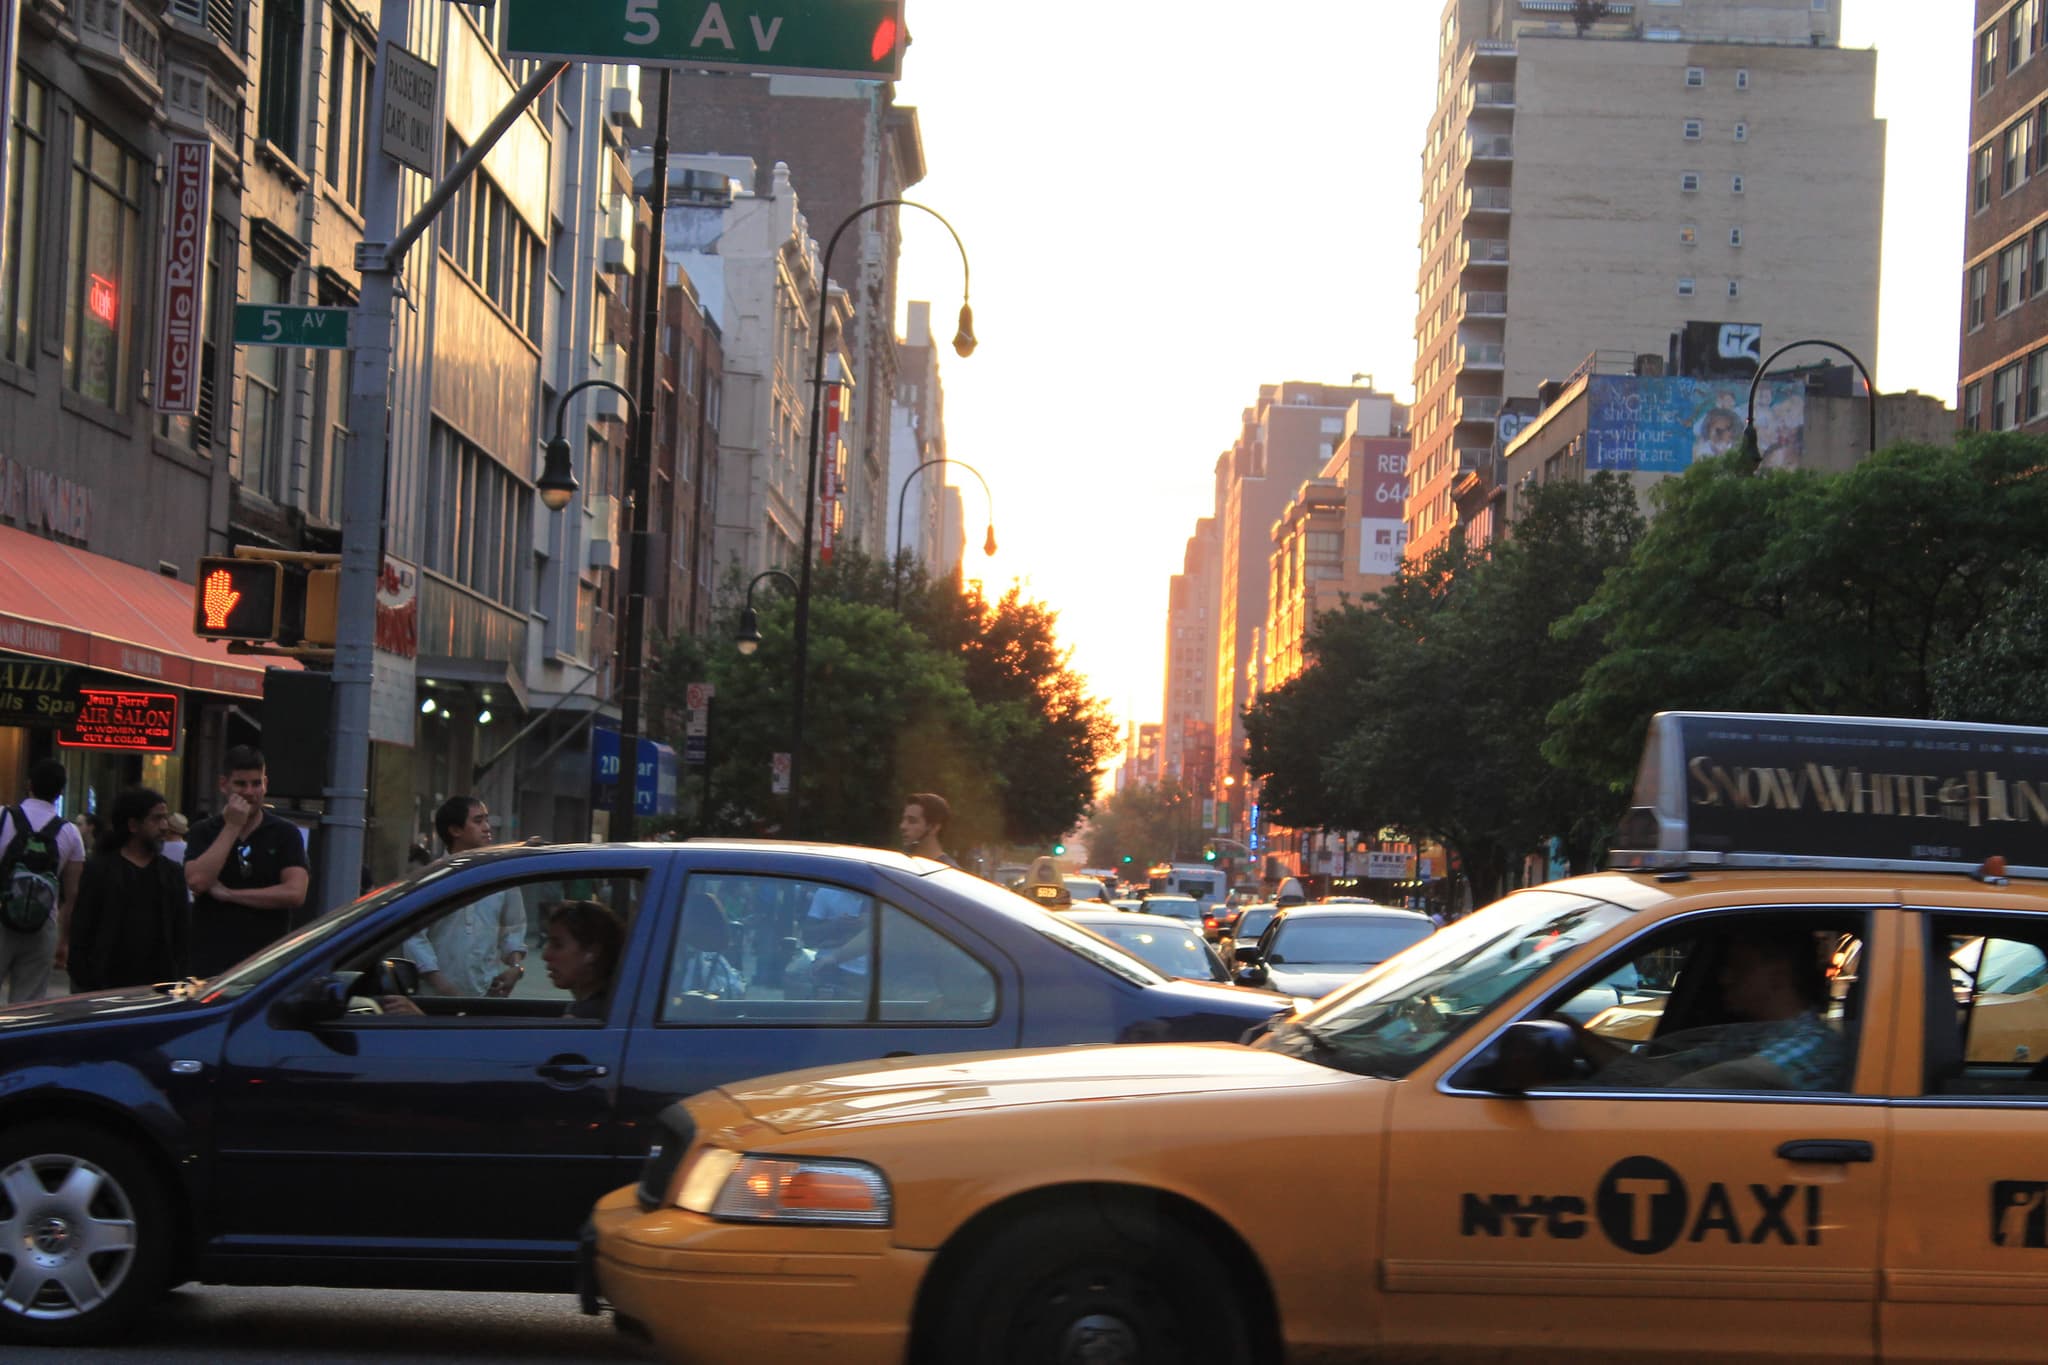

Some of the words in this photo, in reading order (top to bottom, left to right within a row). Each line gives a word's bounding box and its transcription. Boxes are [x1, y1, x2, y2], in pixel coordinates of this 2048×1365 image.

[623, 0, 660, 45] 5
[387, 59, 433, 111] PASSENGER
[385, 103, 408, 142] CARS
[410, 116, 431, 153] ONLY
[168, 146, 200, 287] Roberts
[261, 309, 283, 341] 5
[302, 311, 326, 328] AV
[166, 293, 191, 409] Lucille
[36, 695, 76, 717] Spa
[78, 707, 108, 724] AIR
[113, 708, 172, 727] SALON
[87, 695, 113, 706] Jean
[83, 733, 103, 742] CUT
[113, 735, 148, 744] COLOR
[95, 725, 136, 735] WOMEN
[1688, 756, 1804, 810] SNOW
[1804, 761, 1940, 819] WHITE
[1461, 1192, 1591, 1240] NYC
